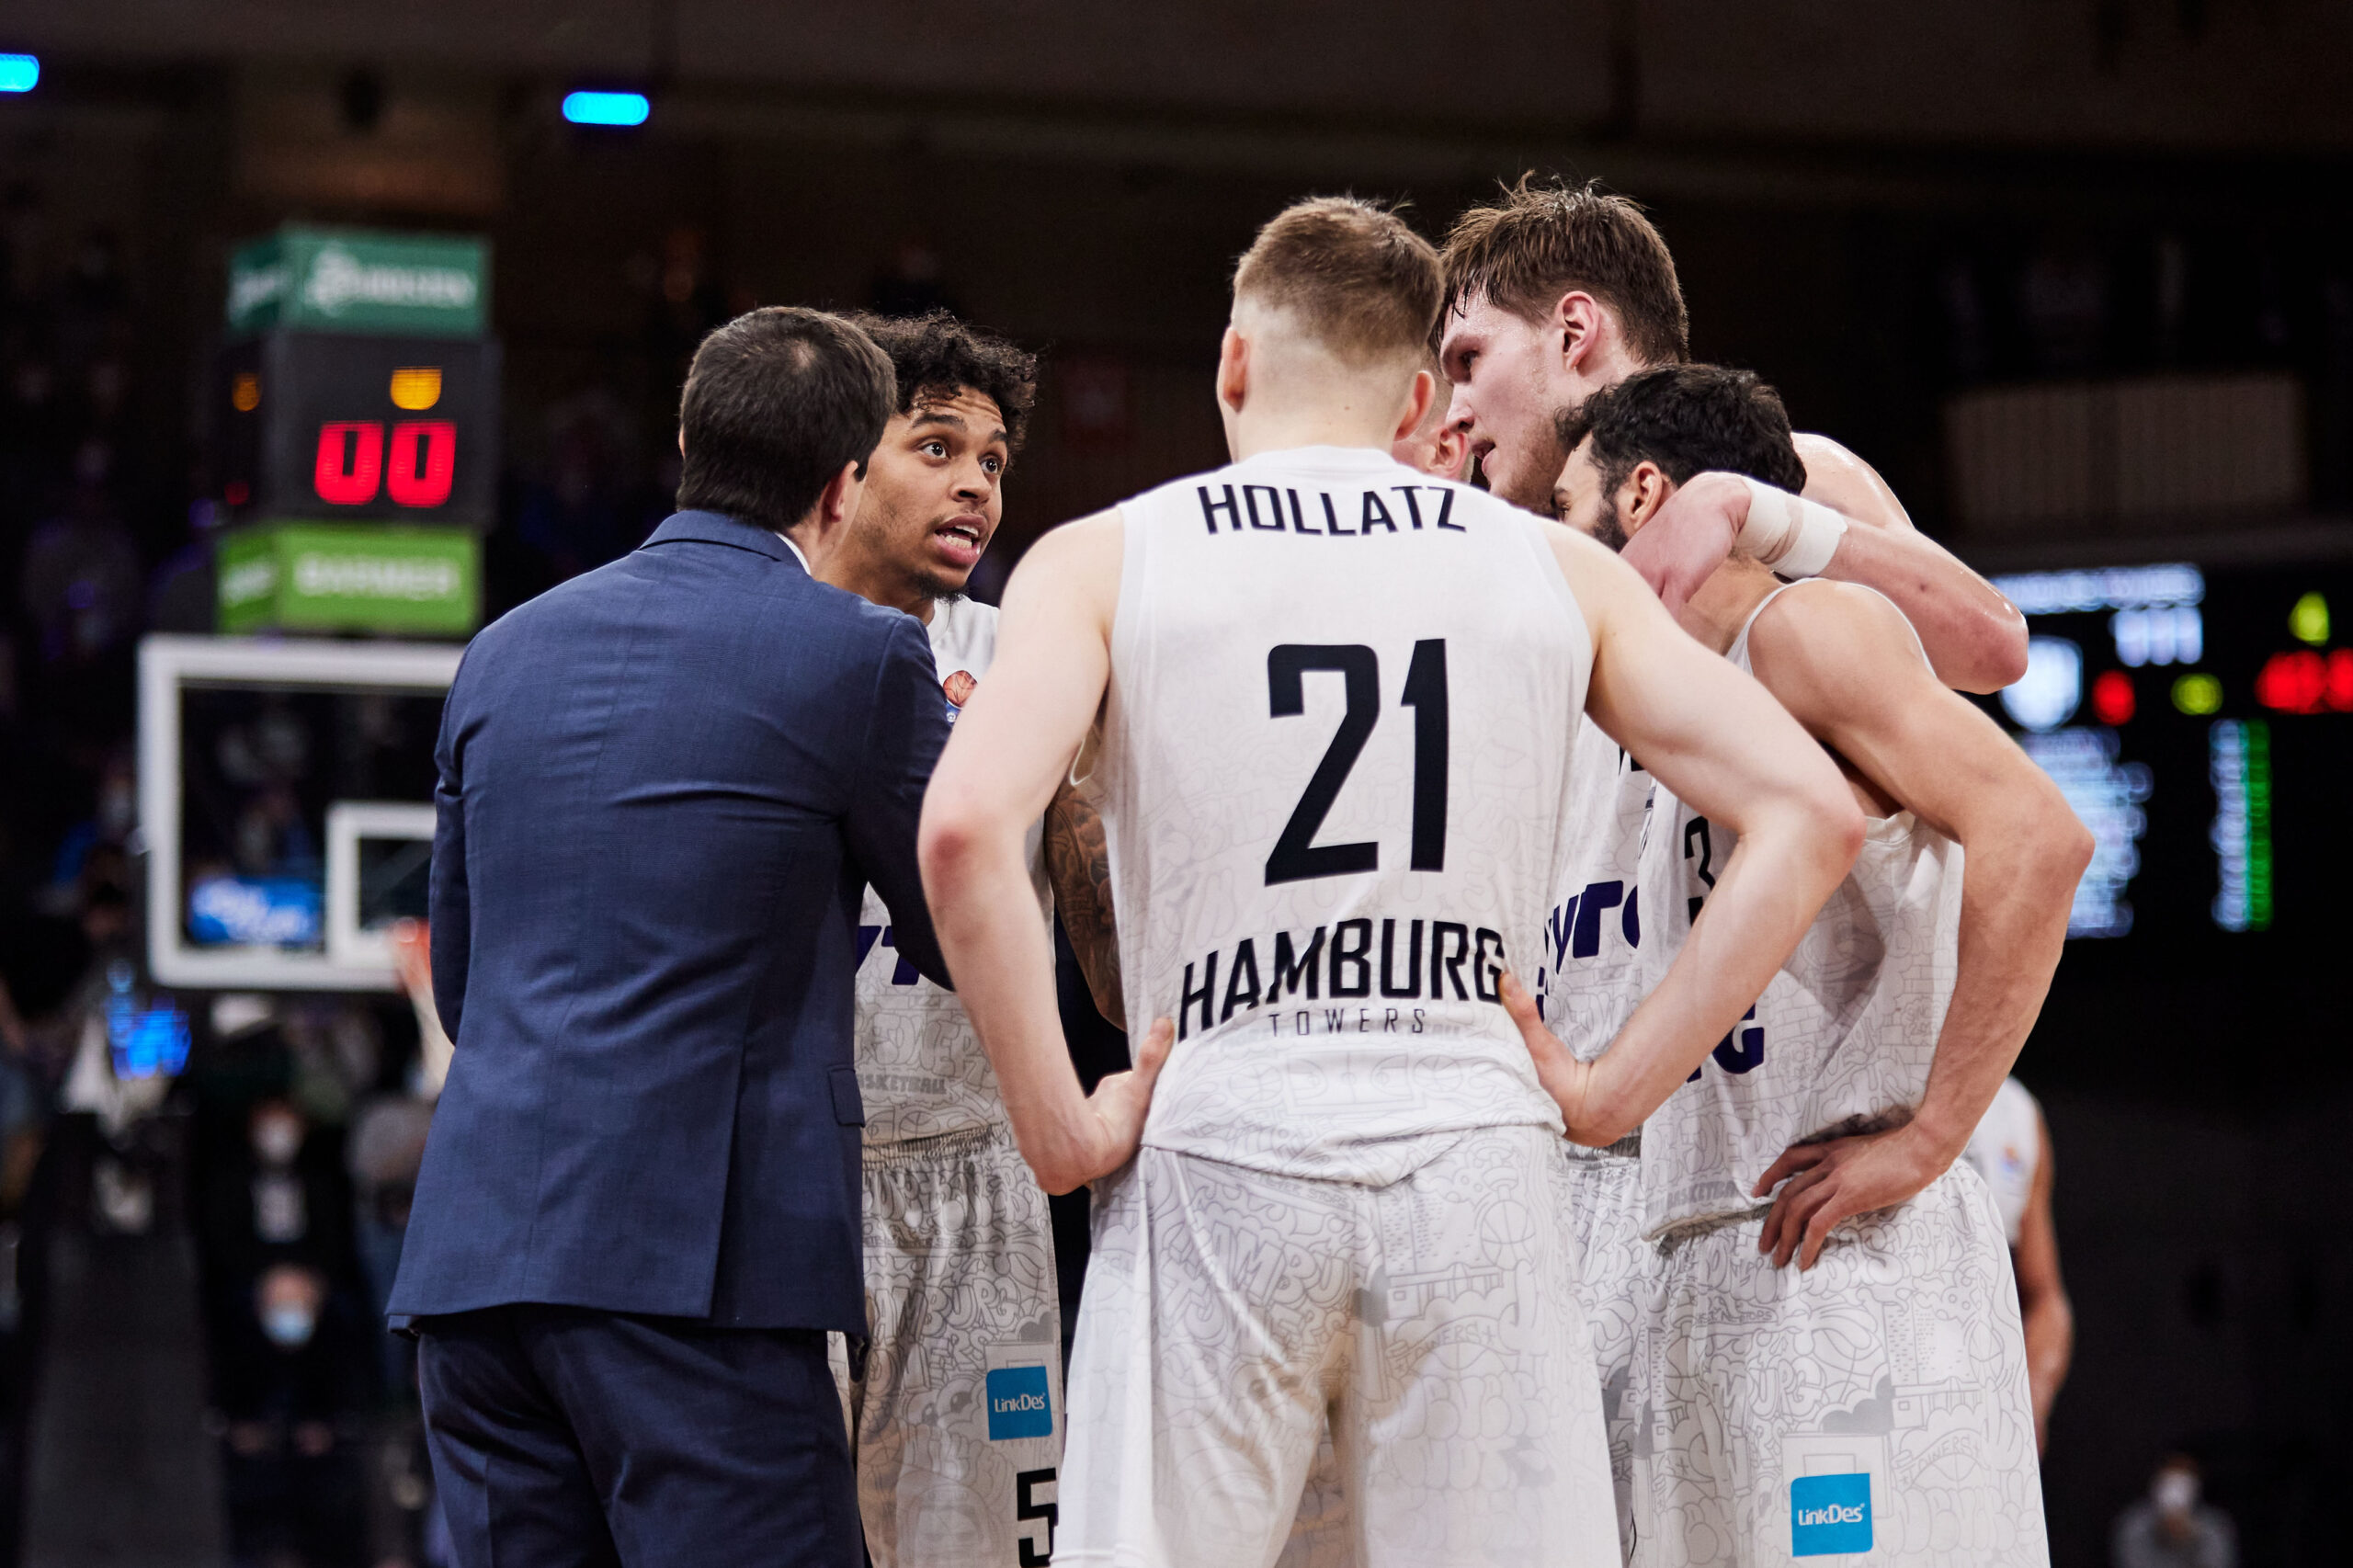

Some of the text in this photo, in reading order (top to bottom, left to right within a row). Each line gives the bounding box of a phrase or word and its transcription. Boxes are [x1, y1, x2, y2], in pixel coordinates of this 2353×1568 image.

[1197, 483, 1468, 536] HOLLATZ
[1264, 638, 1449, 887] 21
[1177, 918, 1506, 1044] HAMBURG
[1268, 1008, 1427, 1037] TOWERS
[994, 1392, 1046, 1413] LinkDes
[1016, 1467, 1058, 1568] 5
[1798, 1503, 1865, 1527] LinkDes
